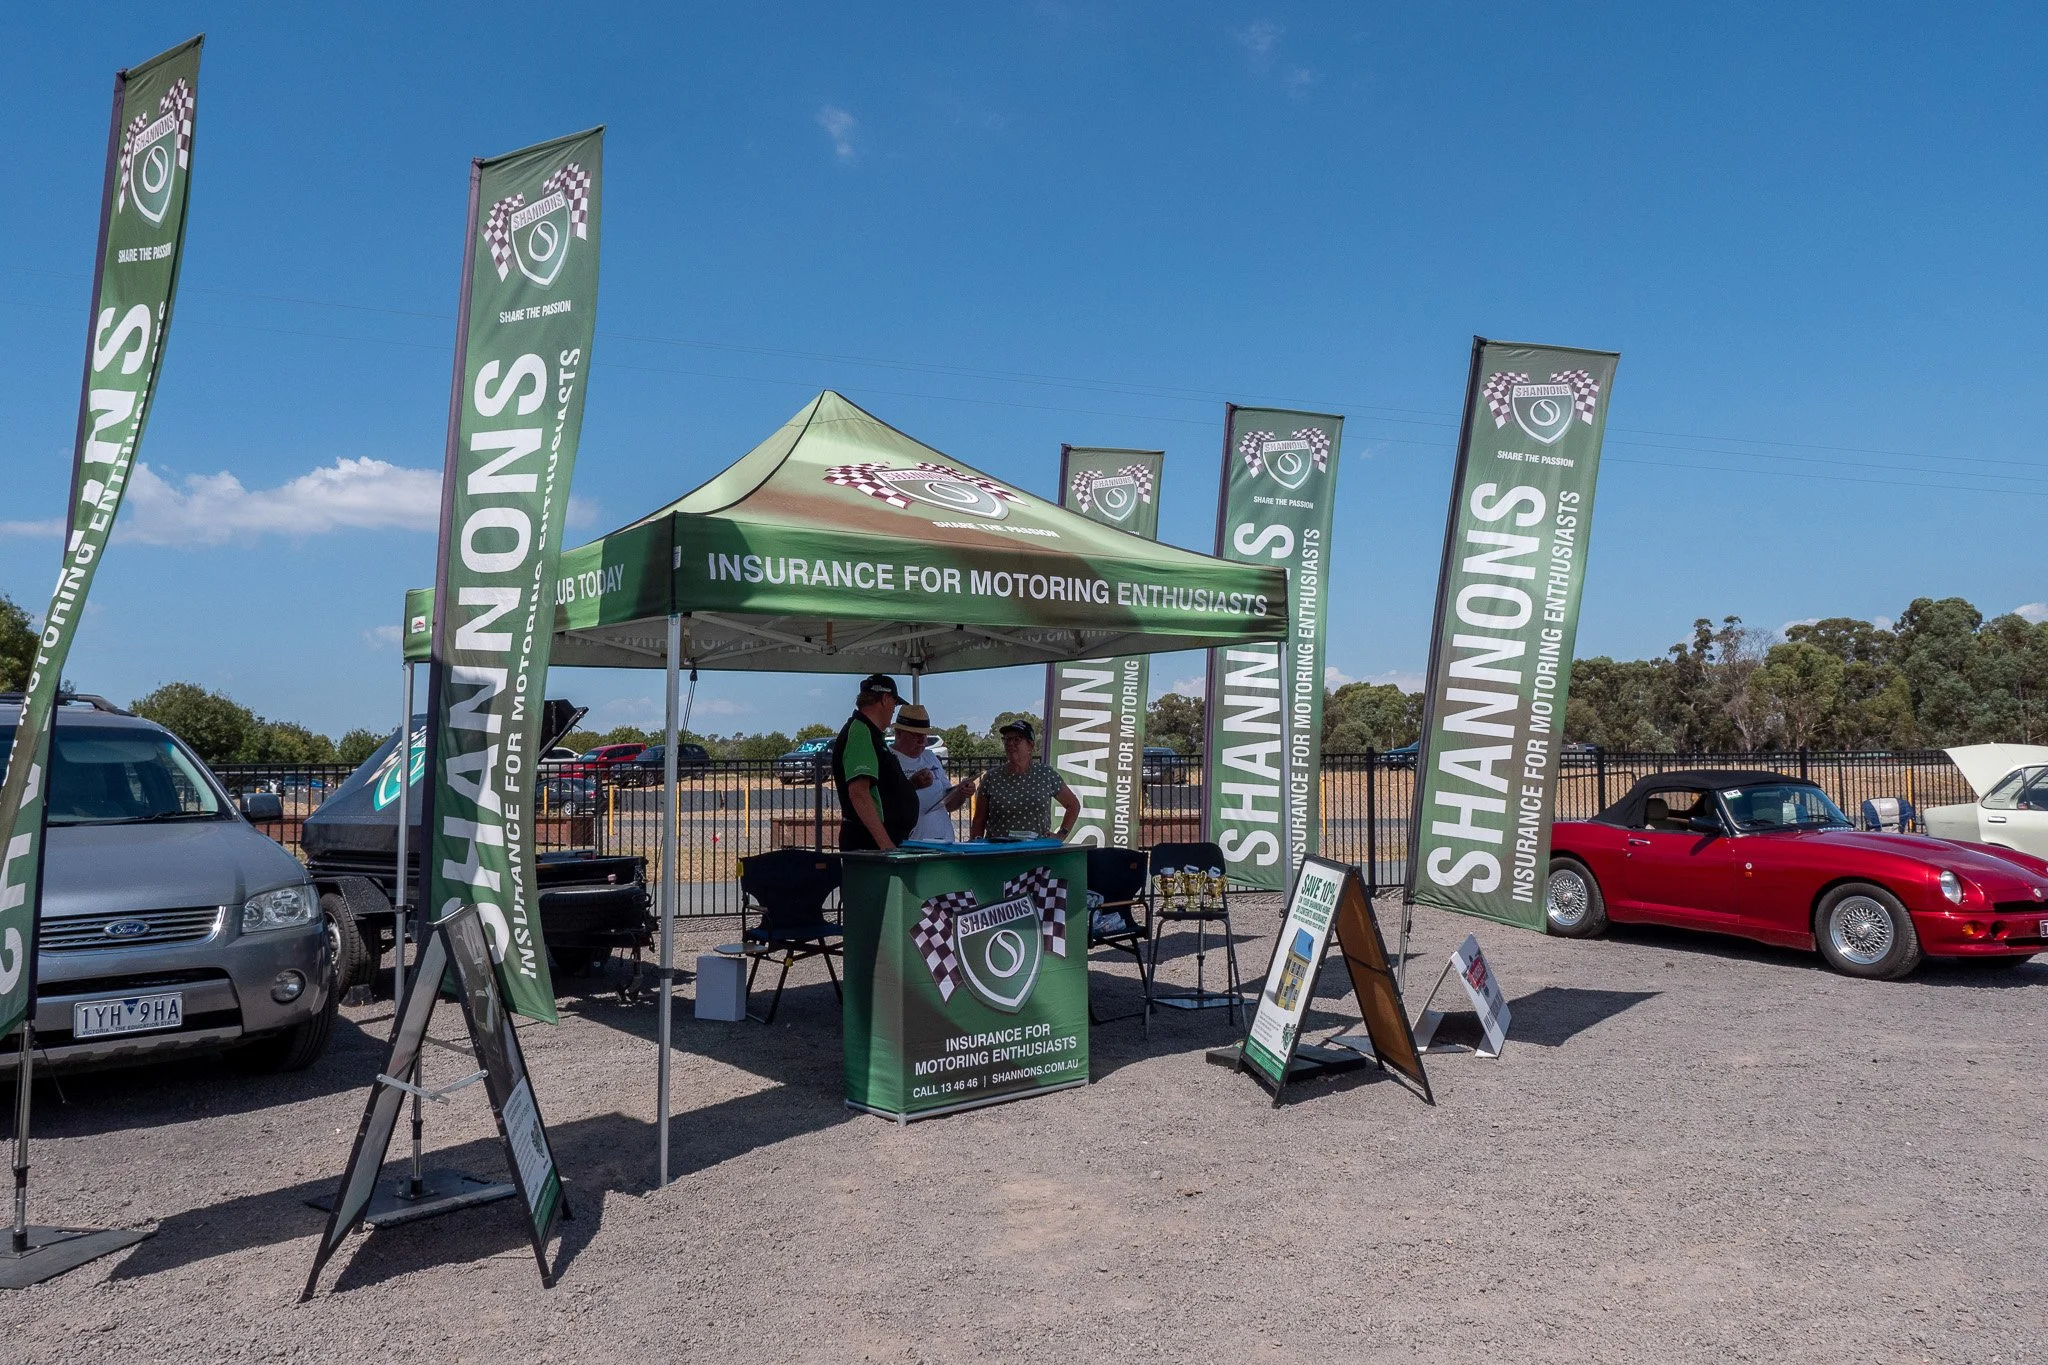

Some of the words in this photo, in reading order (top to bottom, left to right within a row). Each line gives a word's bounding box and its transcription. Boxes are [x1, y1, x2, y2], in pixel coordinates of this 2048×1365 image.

[134, 114, 175, 152] SHANNONS
[512, 194, 563, 230] SHANNONS
[118, 248, 137, 263] SHARE
[139, 246, 151, 261] THE
[153, 242, 171, 259] PASSION
[500, 309, 524, 324] SHARE
[525, 306, 540, 319] THE
[542, 300, 571, 316] PASSION
[1515, 385, 1568, 397] SHANNONS
[1264, 440, 1308, 451] SHANNONS
[1497, 450, 1522, 461] SHARE
[1525, 453, 1539, 463] THE
[1541, 456, 1574, 467] PASSION
[1094, 476, 1132, 488] SHANNONS
[1253, 495, 1274, 505] SHARE
[1275, 497, 1287, 506] THE
[1289, 499, 1314, 509] PASSION
[933, 521, 978, 530] SHARE
[979, 523, 1005, 532] THE
[1006, 525, 1060, 538] PASSION
[1545, 490, 1580, 624] ENTHUSIASTS
[577, 563, 625, 600] TODAY
[708, 553, 895, 591] INSURANCE
[904, 565, 961, 594] FOR
[970, 570, 1109, 604] MOTORING
[1117, 582, 1268, 617] ENTHUSIASTS
[1298, 528, 1320, 639] ENTHUSIASTS
[441, 354, 548, 964] SHANNONS
[511, 560, 543, 721] MOTORING
[1218, 522, 1294, 866] SHANNS
[1294, 643, 1314, 729] MOTORING
[1426, 482, 1546, 894] SHANNONS
[1530, 627, 1562, 732] MOTORING
[1120, 660, 1139, 738] MOTORING
[505, 732, 522, 793] FOR
[1118, 742, 1134, 771] FOR
[1292, 734, 1310, 767] FOR
[1524, 733, 1548, 779] FOR
[1292, 772, 1309, 869] INSURANCE
[1512, 786, 1543, 903] INSURANCE
[505, 803, 536, 979] INSURANCE
[1301, 874, 1323, 899] SAVE
[1320, 880, 1337, 906] 10%
[115, 925, 141, 935] Ford
[960, 899, 1031, 935] SHANNONS
[82, 1003, 121, 1029] 1YH
[139, 998, 179, 1022] 9HA
[82, 1027, 109, 1036] VICTORIA
[128, 1022, 159, 1030] EDUCATION
[915, 1052, 989, 1076] MOTORING
[993, 1035, 1077, 1063] ENTHUSIASTS
[946, 1027, 1022, 1052] INSURANCE
[1025, 1023, 1051, 1038] FOR
[913, 1084, 938, 1098] CALL
[941, 1082, 951, 1093] 13
[954, 1080, 966, 1091] 46
[967, 1078, 978, 1089] 46
[992, 1058, 1079, 1084] SHANNONS.COM.AU
